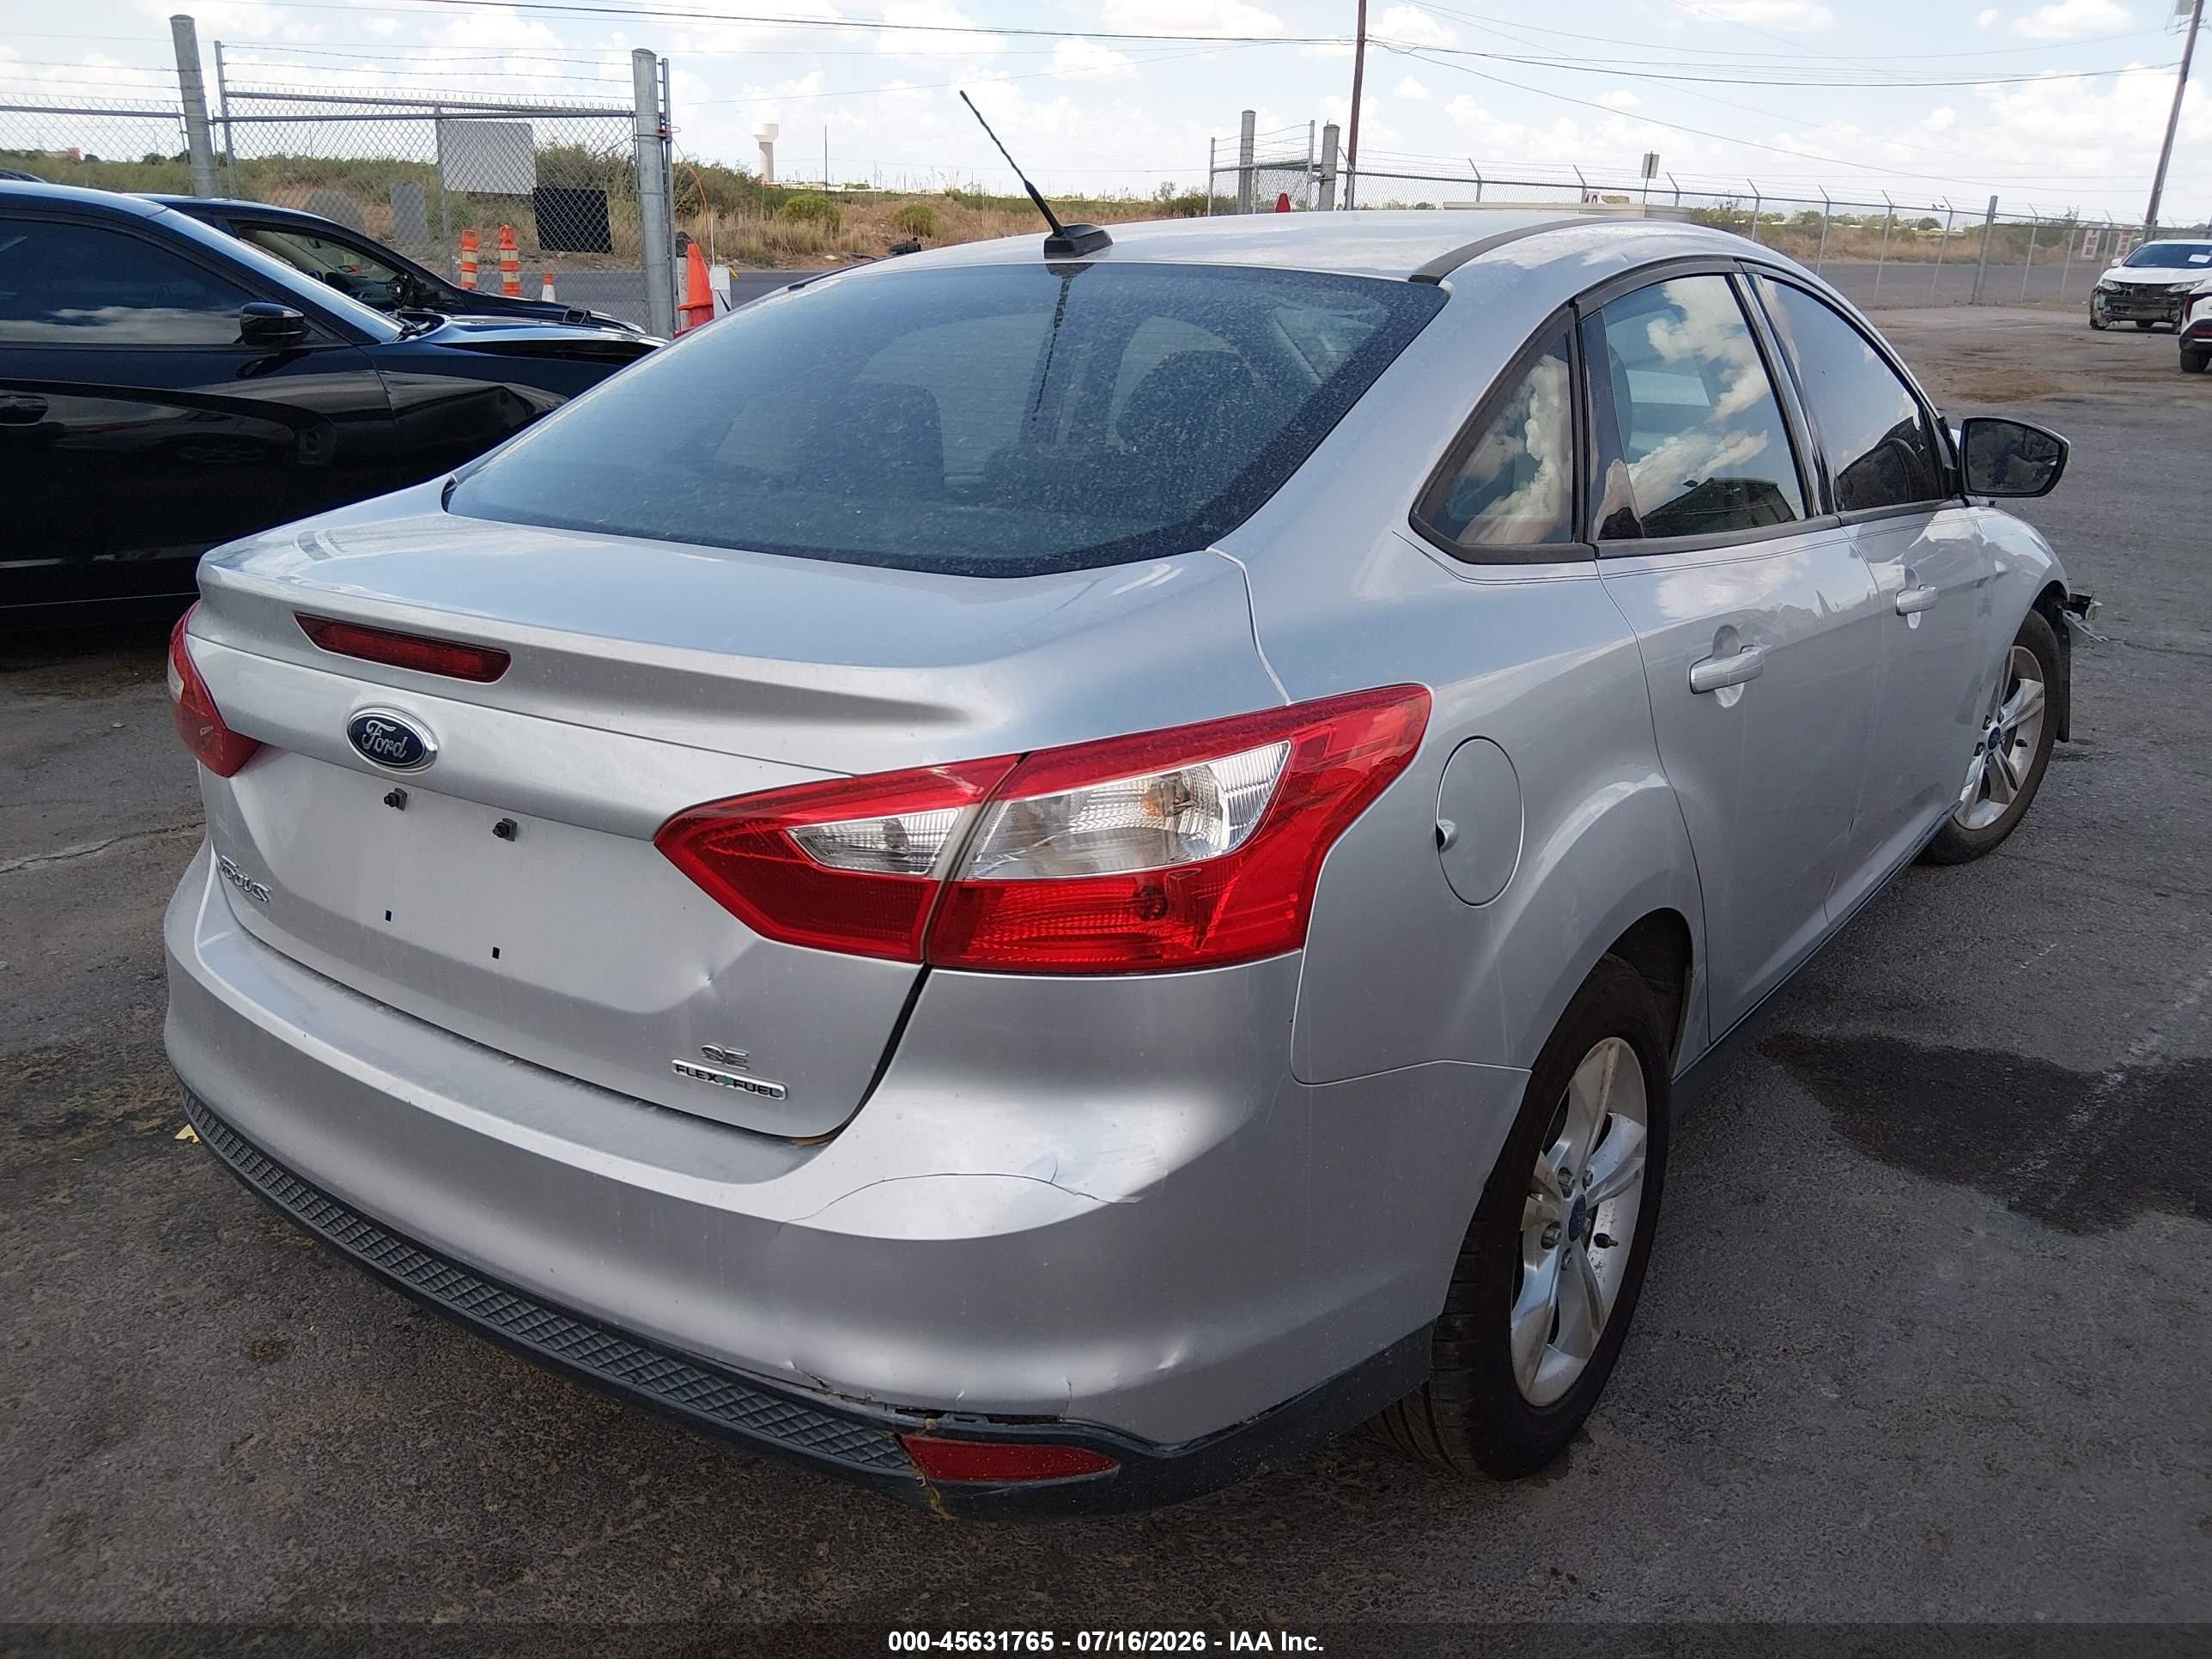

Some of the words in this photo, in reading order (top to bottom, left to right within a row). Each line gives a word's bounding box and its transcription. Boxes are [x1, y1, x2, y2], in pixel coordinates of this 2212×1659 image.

[362, 720, 408, 758] Ford
[701, 1043, 750, 1070] SE
[676, 1064, 719, 1083] FLEX
[733, 1079, 781, 1098] FUEL
